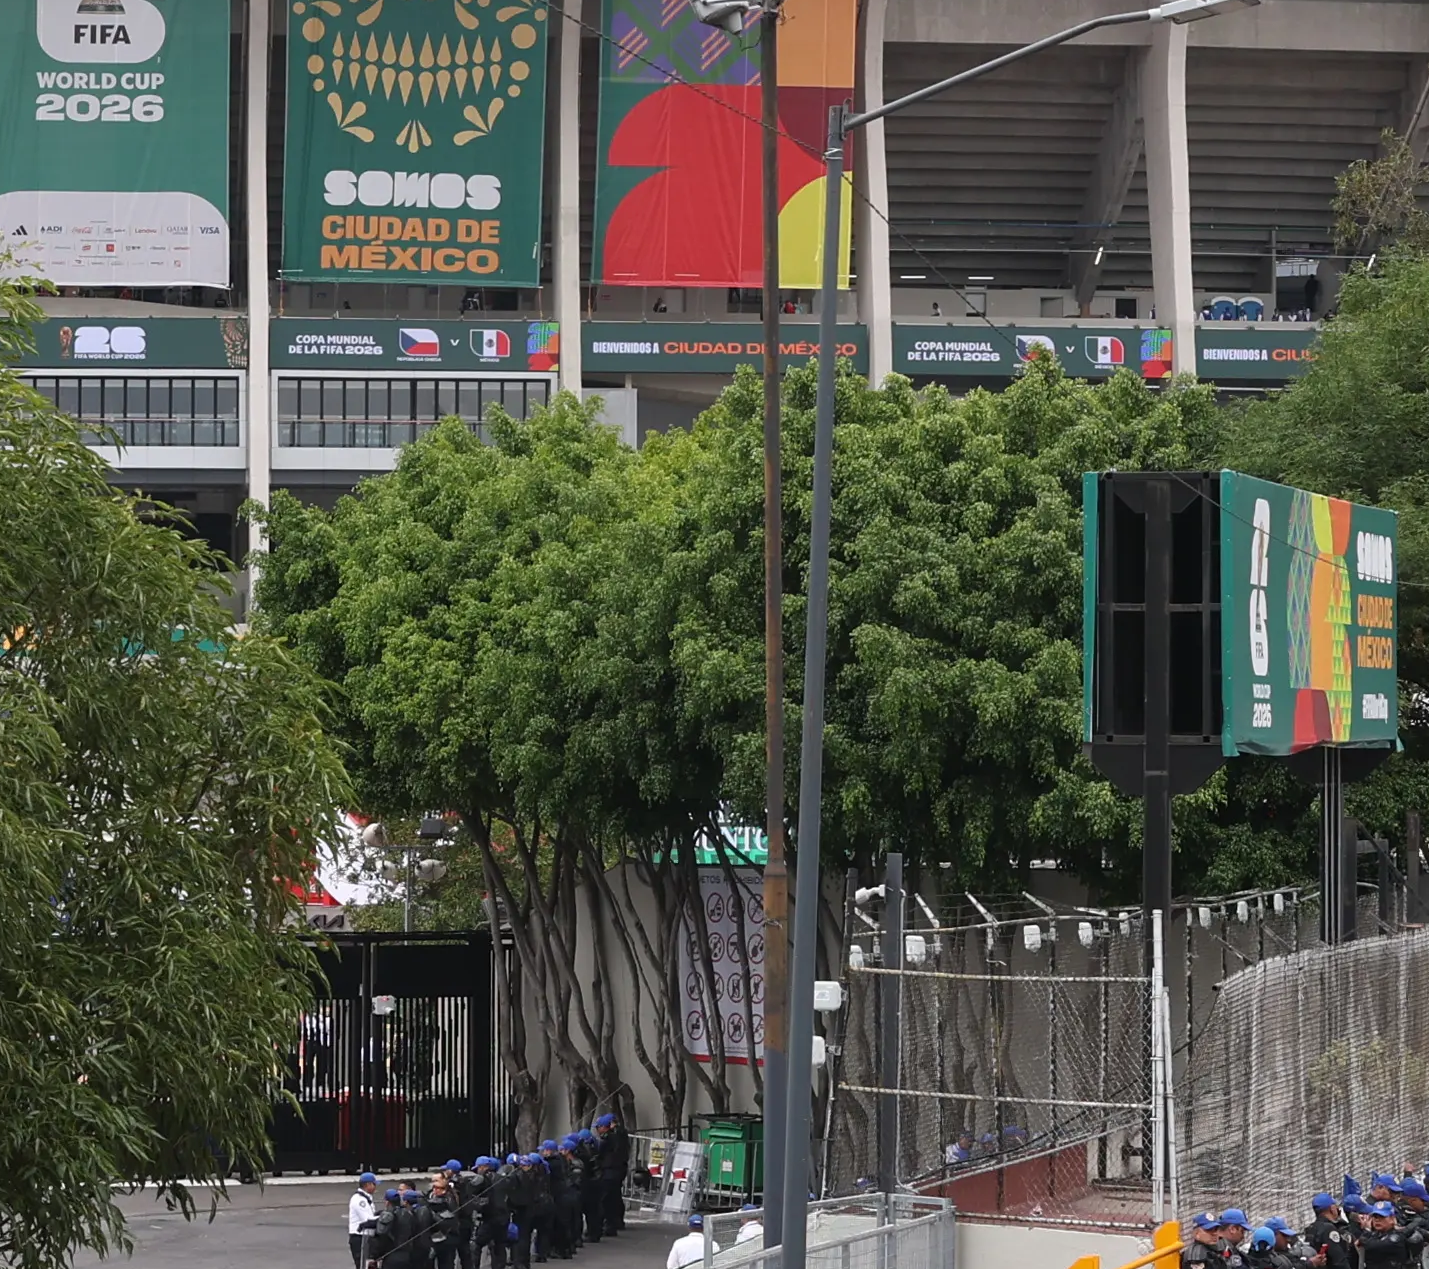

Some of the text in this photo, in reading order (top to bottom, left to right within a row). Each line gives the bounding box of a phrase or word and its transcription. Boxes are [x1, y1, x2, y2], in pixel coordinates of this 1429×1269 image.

[74, 24, 131, 45] FIFA
[36, 71, 165, 91] WORLD CUP
[35, 93, 165, 123] 2026
[323, 170, 502, 211] SOMOS
[46, 226, 63, 234] ADI
[200, 226, 220, 235] VISA
[321, 215, 500, 244] CIUDAD DE
[319, 237, 500, 274] MÉXICO
[288, 345, 384, 355] DE LA FIFA 2026
[295, 335, 376, 345] COPA MUNDIAL
[592, 342, 652, 354] BIENVENIDOS
[652, 342, 660, 354] A
[664, 342, 743, 355] CIUDAD
[914, 341, 993, 352] COPA MUNDIAL
[907, 351, 1001, 362] DE LA FIFA 2026
[1202, 348, 1268, 361] BIENVENIDOS A
[1356, 531, 1394, 585] SOMOS
[1357, 594, 1383, 628] CIUDAD
[1255, 641, 1265, 660] FIFA
[1357, 629, 1393, 670] MÉXICO
[1252, 702, 1272, 729] 2026
